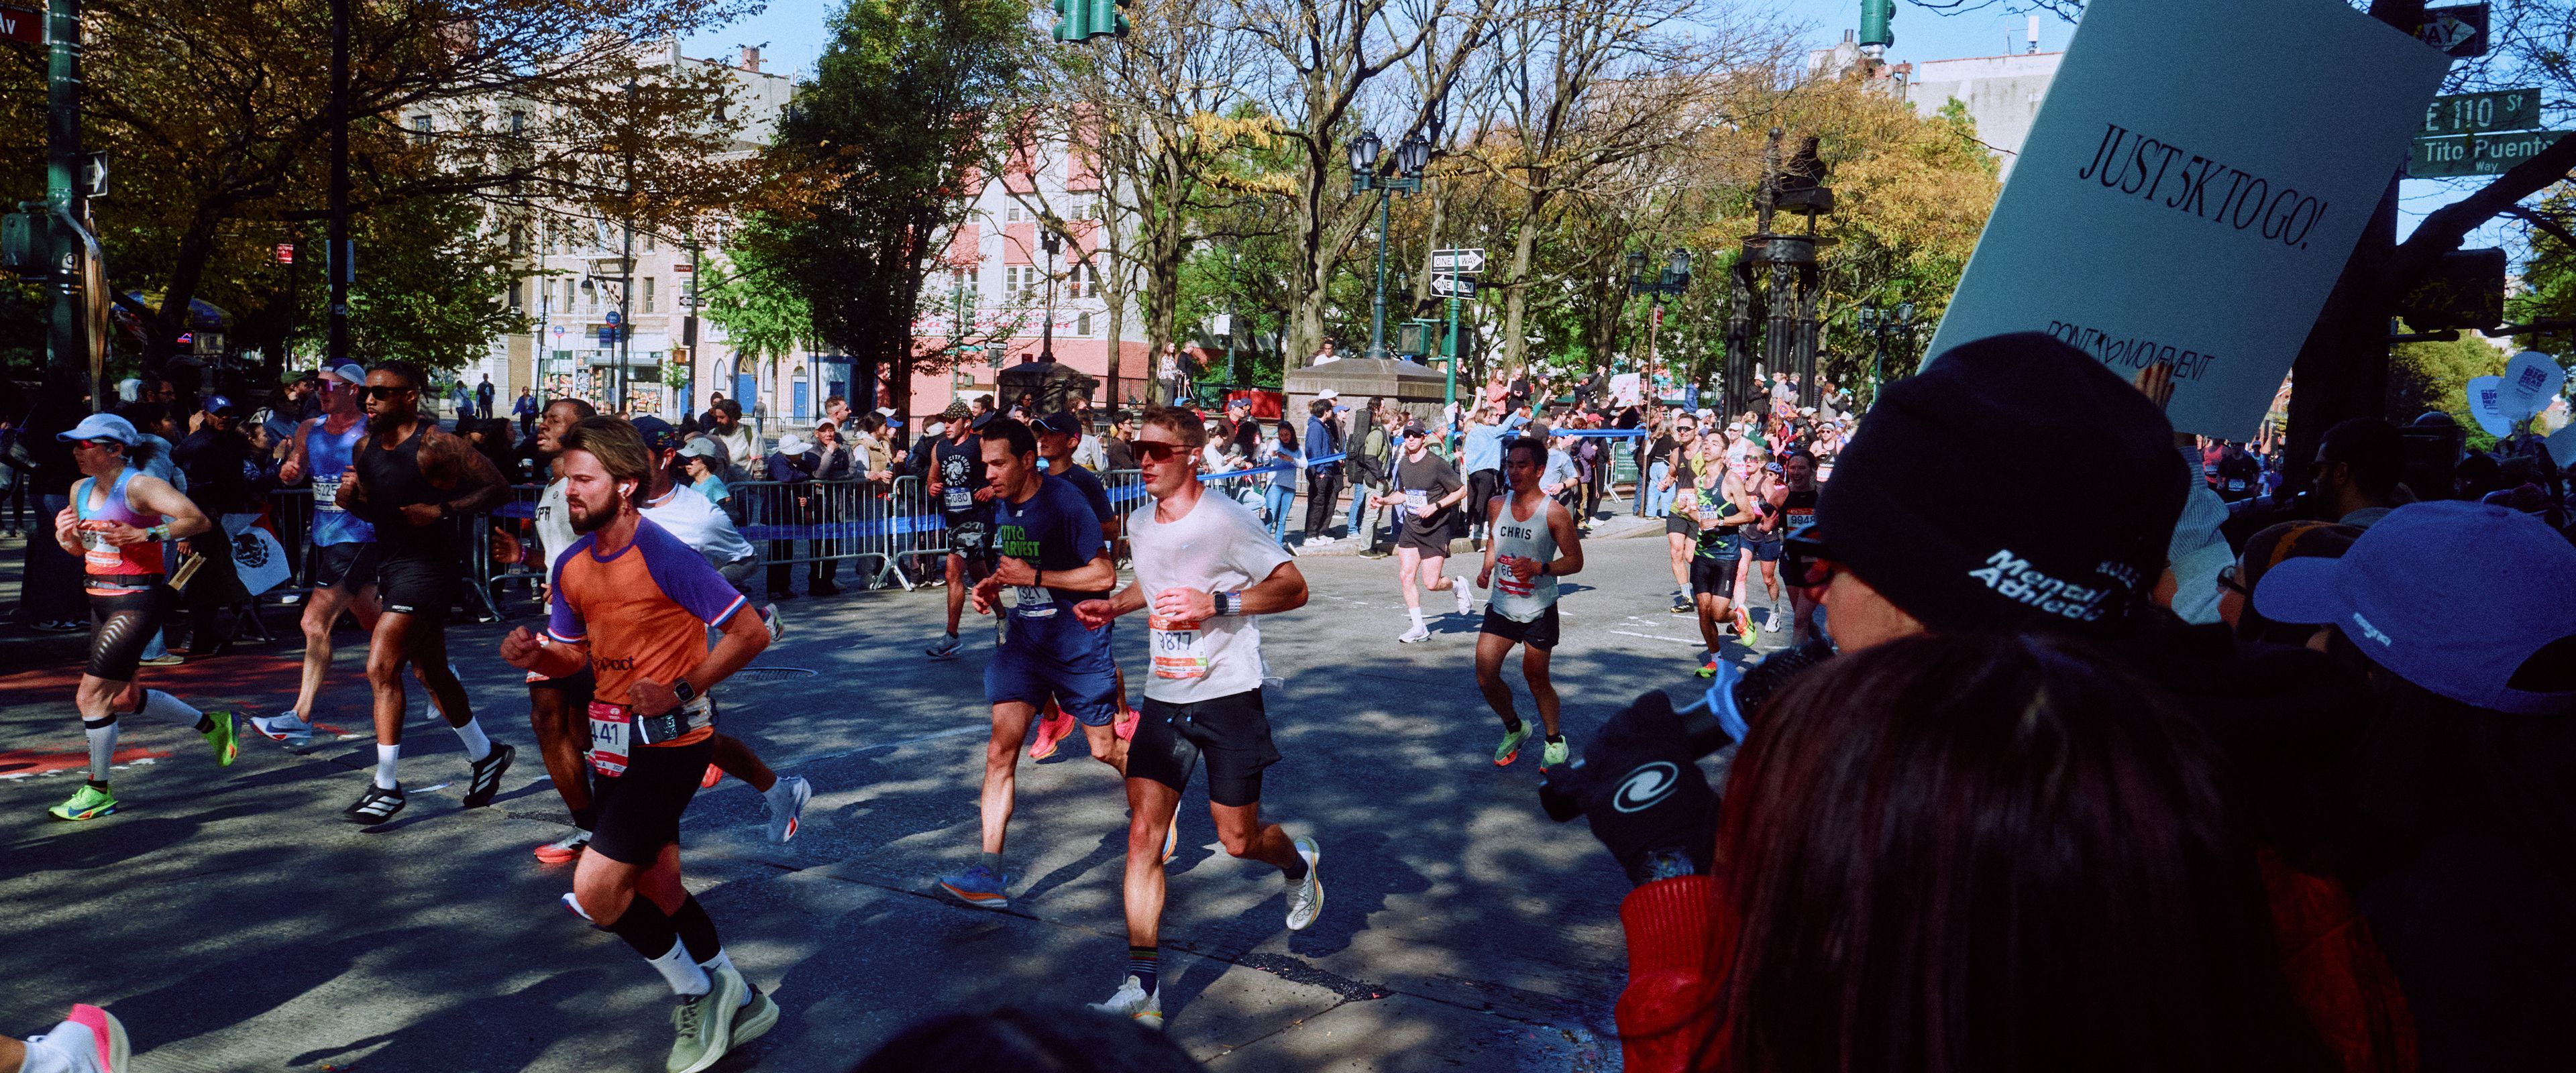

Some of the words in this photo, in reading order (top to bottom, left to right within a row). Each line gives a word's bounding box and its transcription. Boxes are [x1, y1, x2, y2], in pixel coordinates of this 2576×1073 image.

[2425, 24, 2459, 45] AY
[2426, 103, 2440, 131] E
[2454, 98, 2493, 129] 110
[2507, 95, 2524, 111] St
[2425, 142, 2464, 162] Tito
[2476, 161, 2499, 174] Way
[2080, 123, 2184, 201] JUST
[2167, 155, 2227, 217] 5K
[2214, 168, 2268, 229] TO
[2262, 189, 2328, 250] GO!
[1436, 258, 1452, 266] ONE
[1461, 256, 1477, 265] WAY
[1436, 280, 1450, 290] ONE
[1457, 281, 1472, 290] WAY
[2520, 376, 2542, 388] HEAD
[2524, 368, 2546, 383] BIG
[1001, 525, 1016, 541] ITY
[1500, 526, 1532, 540] CHRIS
[1003, 541, 1040, 557] ARVEST
[1018, 586, 1042, 600] 321
